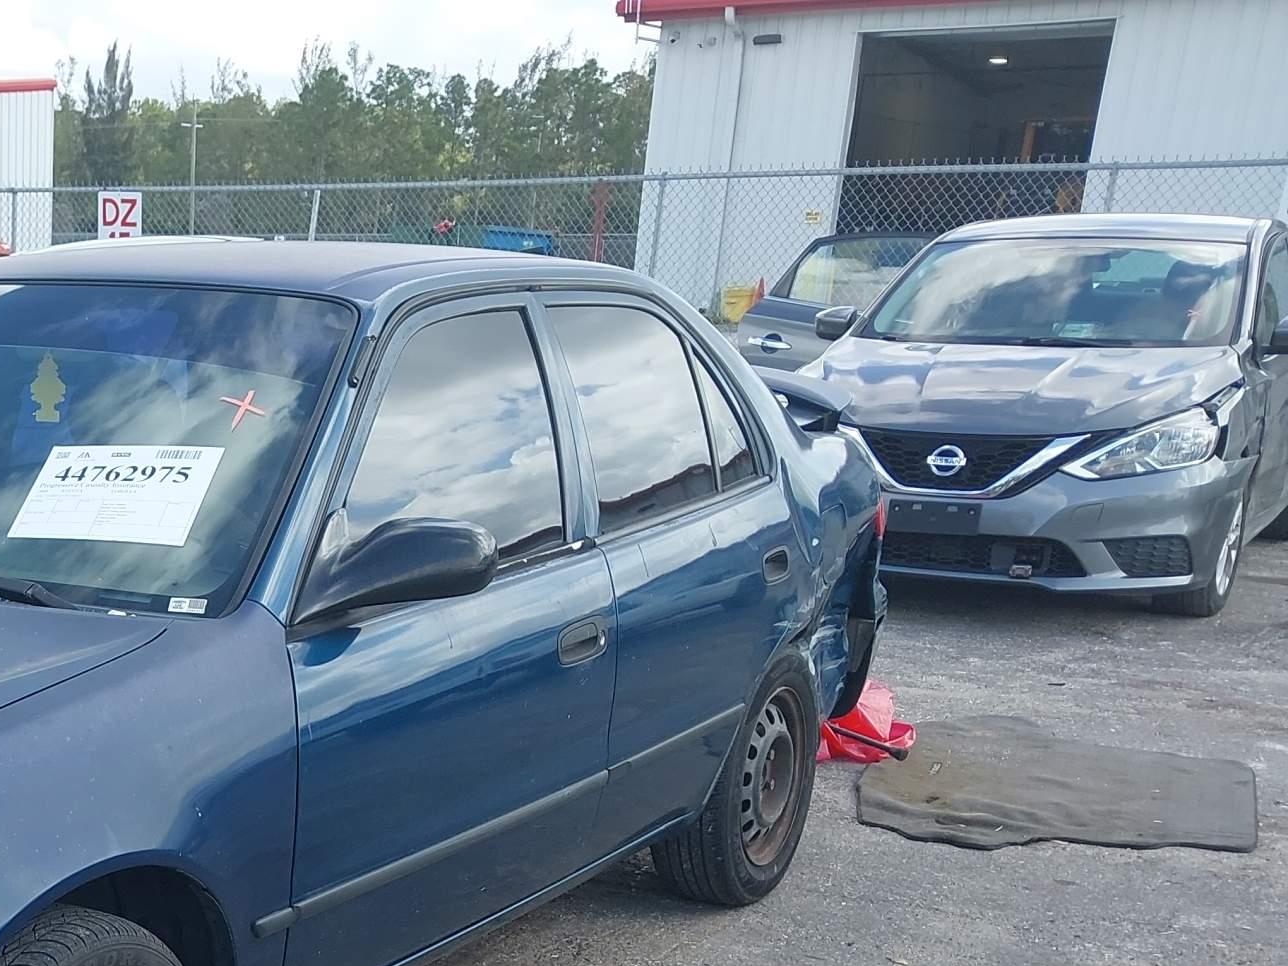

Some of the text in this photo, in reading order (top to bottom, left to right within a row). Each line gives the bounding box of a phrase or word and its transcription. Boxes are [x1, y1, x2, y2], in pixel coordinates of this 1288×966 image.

[103, 198, 137, 227] DZ
[930, 457, 963, 465] NISSAN
[54, 464, 193, 484] 44762975
